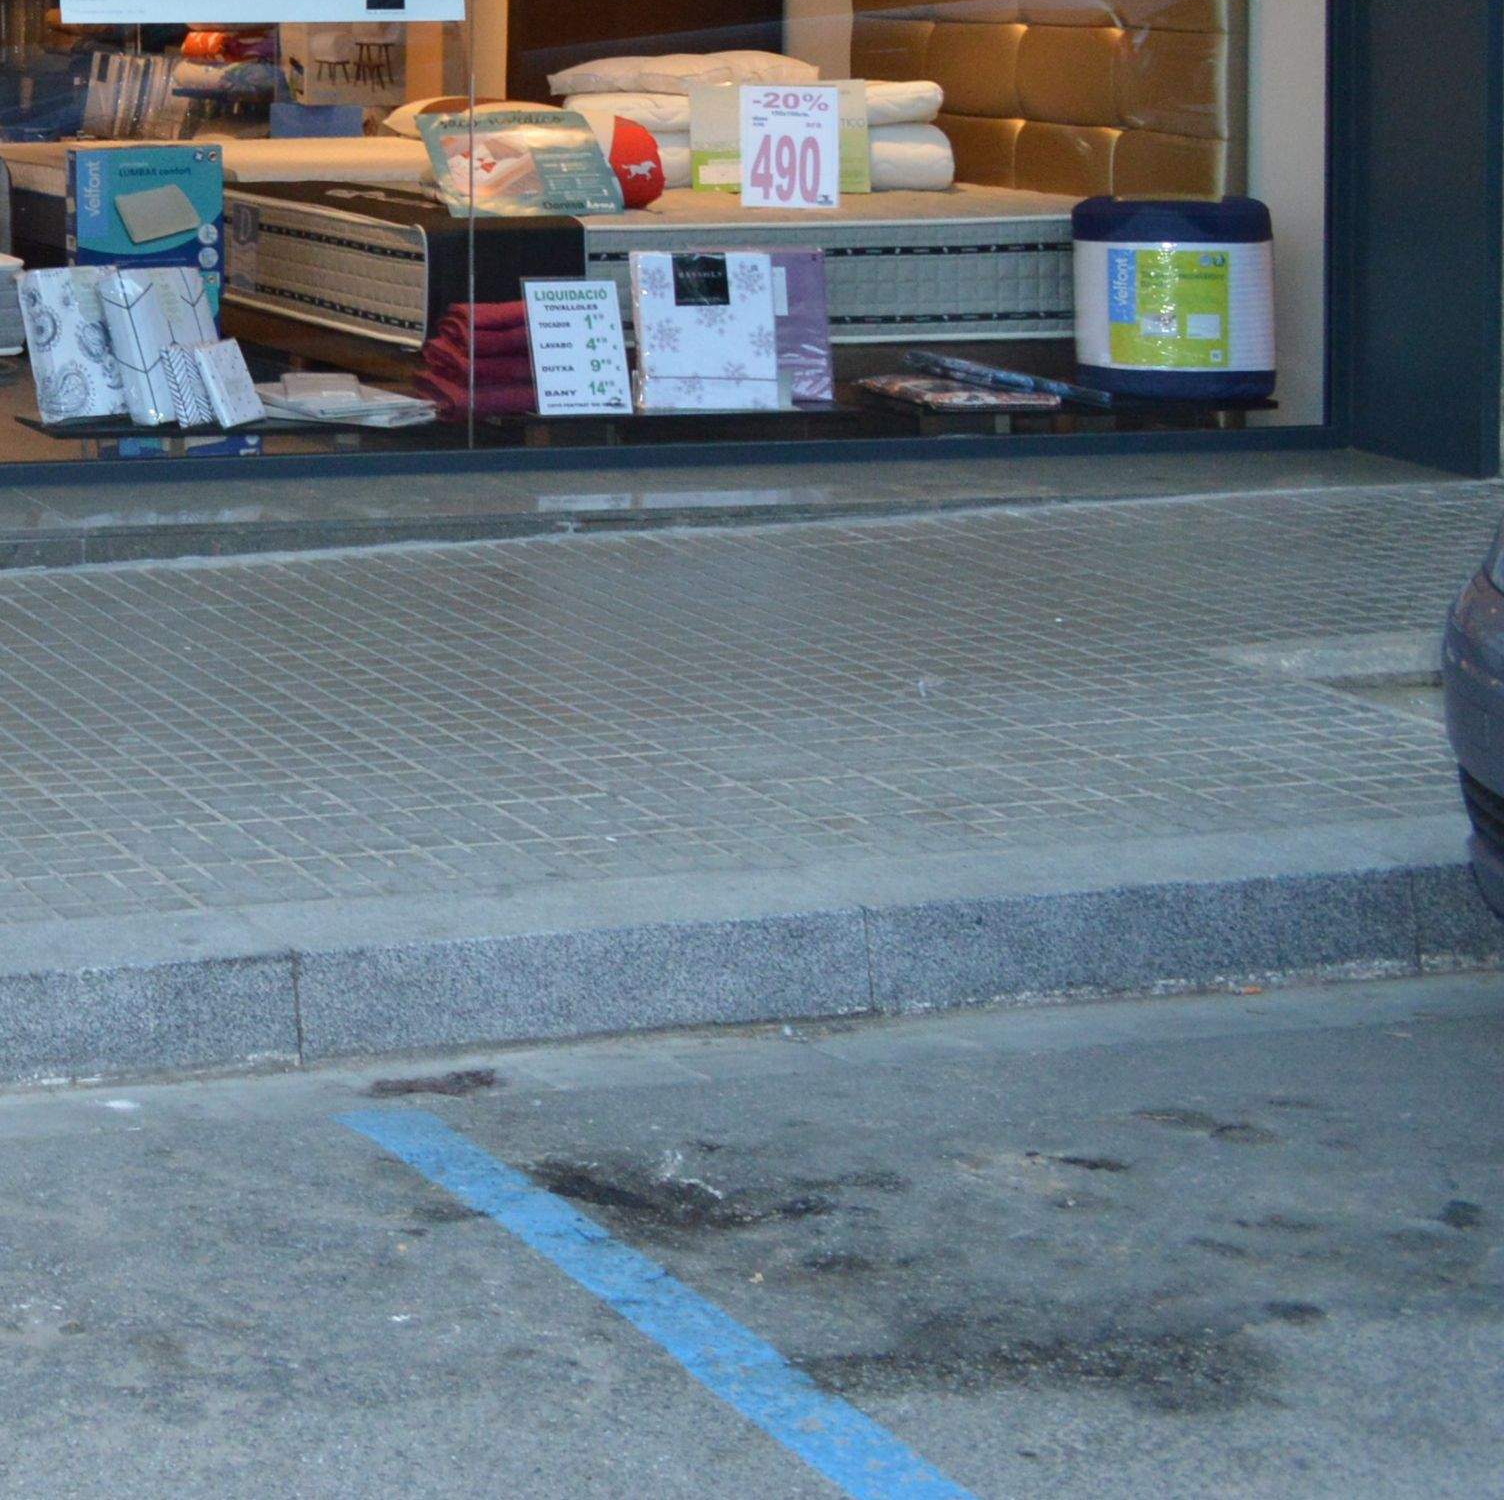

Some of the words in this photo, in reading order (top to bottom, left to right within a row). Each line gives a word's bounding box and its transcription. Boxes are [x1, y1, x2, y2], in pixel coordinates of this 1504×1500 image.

[752, 91, 830, 112] -20%
[840, 117, 866, 128] TICO
[750, 134, 821, 203] 490
[533, 287, 608, 301] LIQUIDACIÓ
[544, 303, 599, 312] TOVALLOLES
[540, 342, 573, 350] LAVABO
[544, 389, 577, 397] BANY
